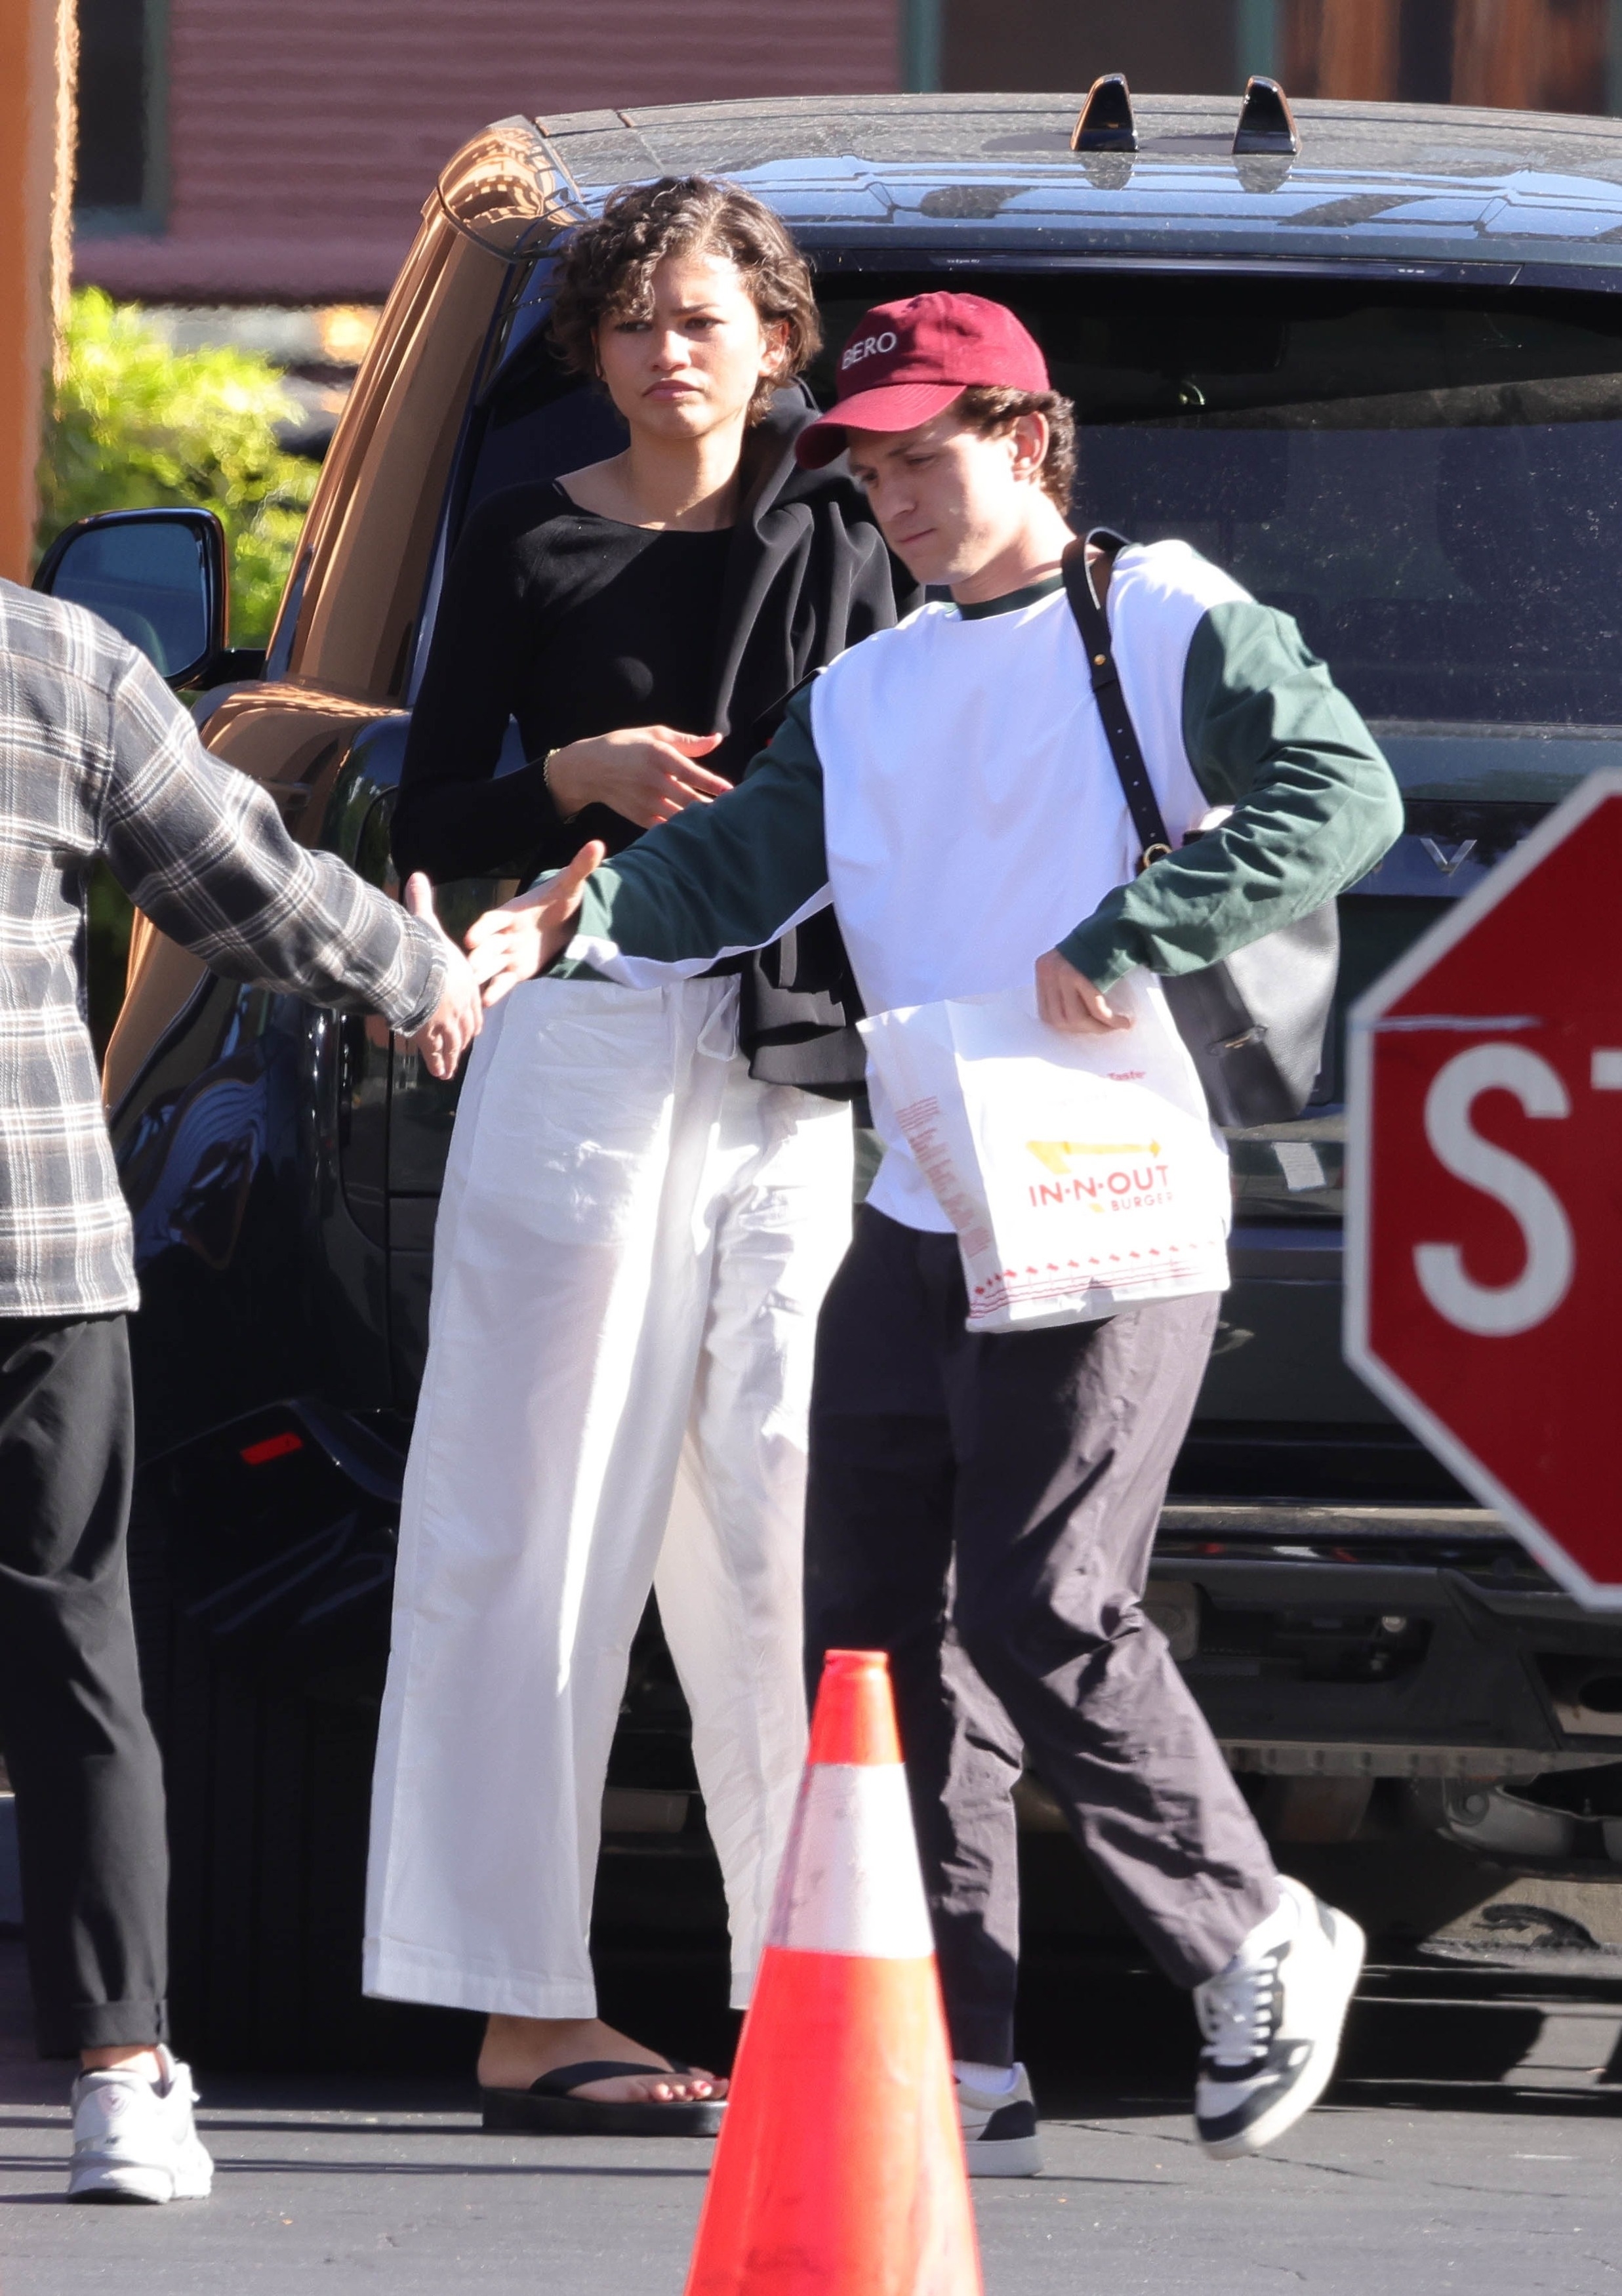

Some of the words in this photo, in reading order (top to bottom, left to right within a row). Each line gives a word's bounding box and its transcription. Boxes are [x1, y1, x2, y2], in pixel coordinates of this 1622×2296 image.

[841, 332, 897, 371] BERO
[1111, 1192, 1172, 1212] BURGER
[1412, 1041, 1622, 1338] S
